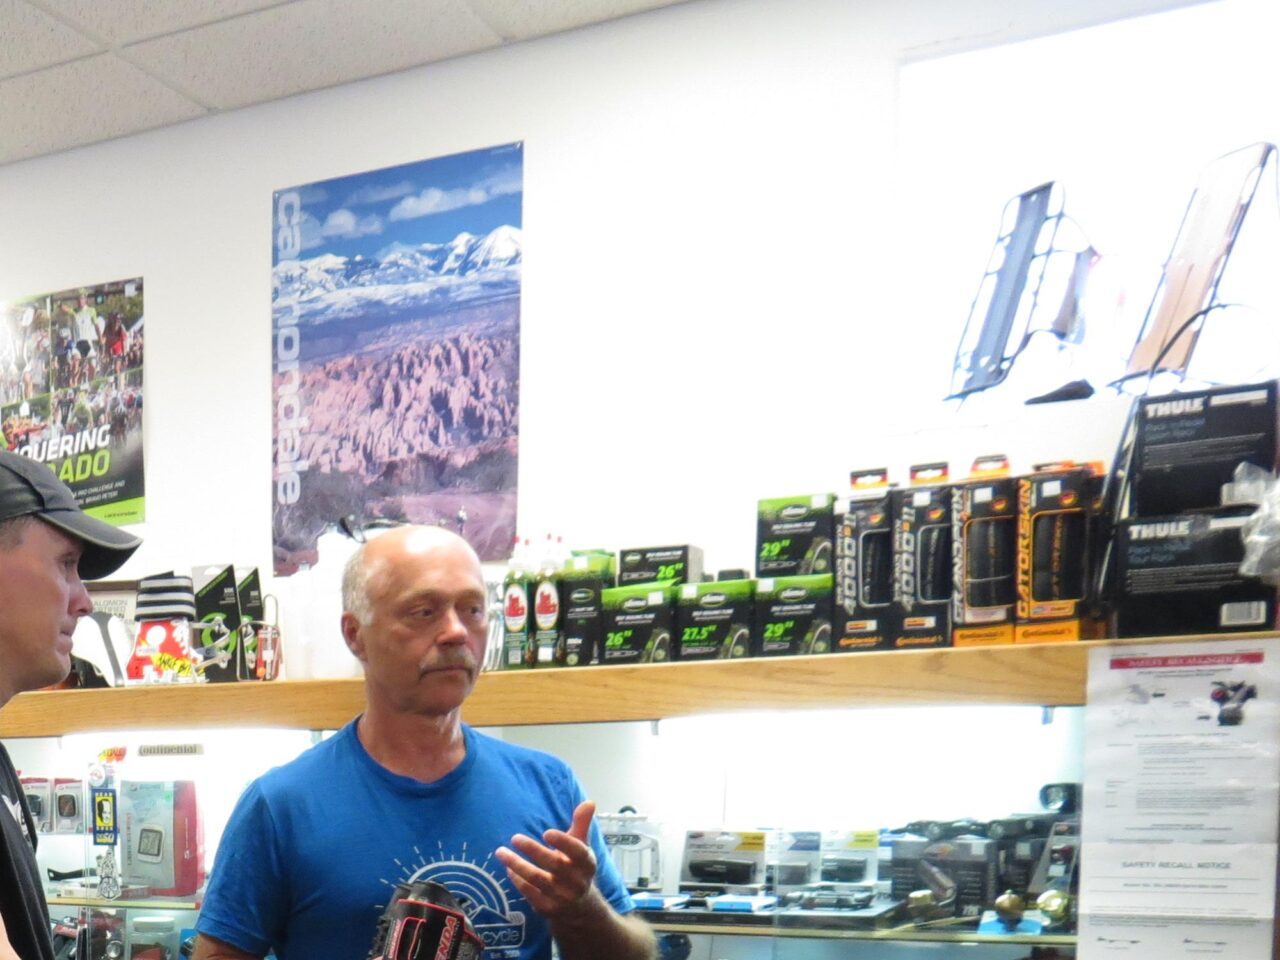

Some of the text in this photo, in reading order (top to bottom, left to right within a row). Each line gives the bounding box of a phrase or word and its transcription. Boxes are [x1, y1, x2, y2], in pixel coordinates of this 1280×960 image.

[1144, 397, 1205, 419] THULE
[1128, 520, 1190, 540] THULE
[760, 538, 792, 558] 29"
[1018, 478, 1032, 619] GATORSKIN
[657, 562, 685, 579] 26"
[605, 630, 633, 646] 26"
[681, 625, 717, 640] 27.5"
[763, 620, 793, 638] 29"
[1122, 861, 1156, 869] SAFETY
[1197, 862, 1231, 870] NOTICE
